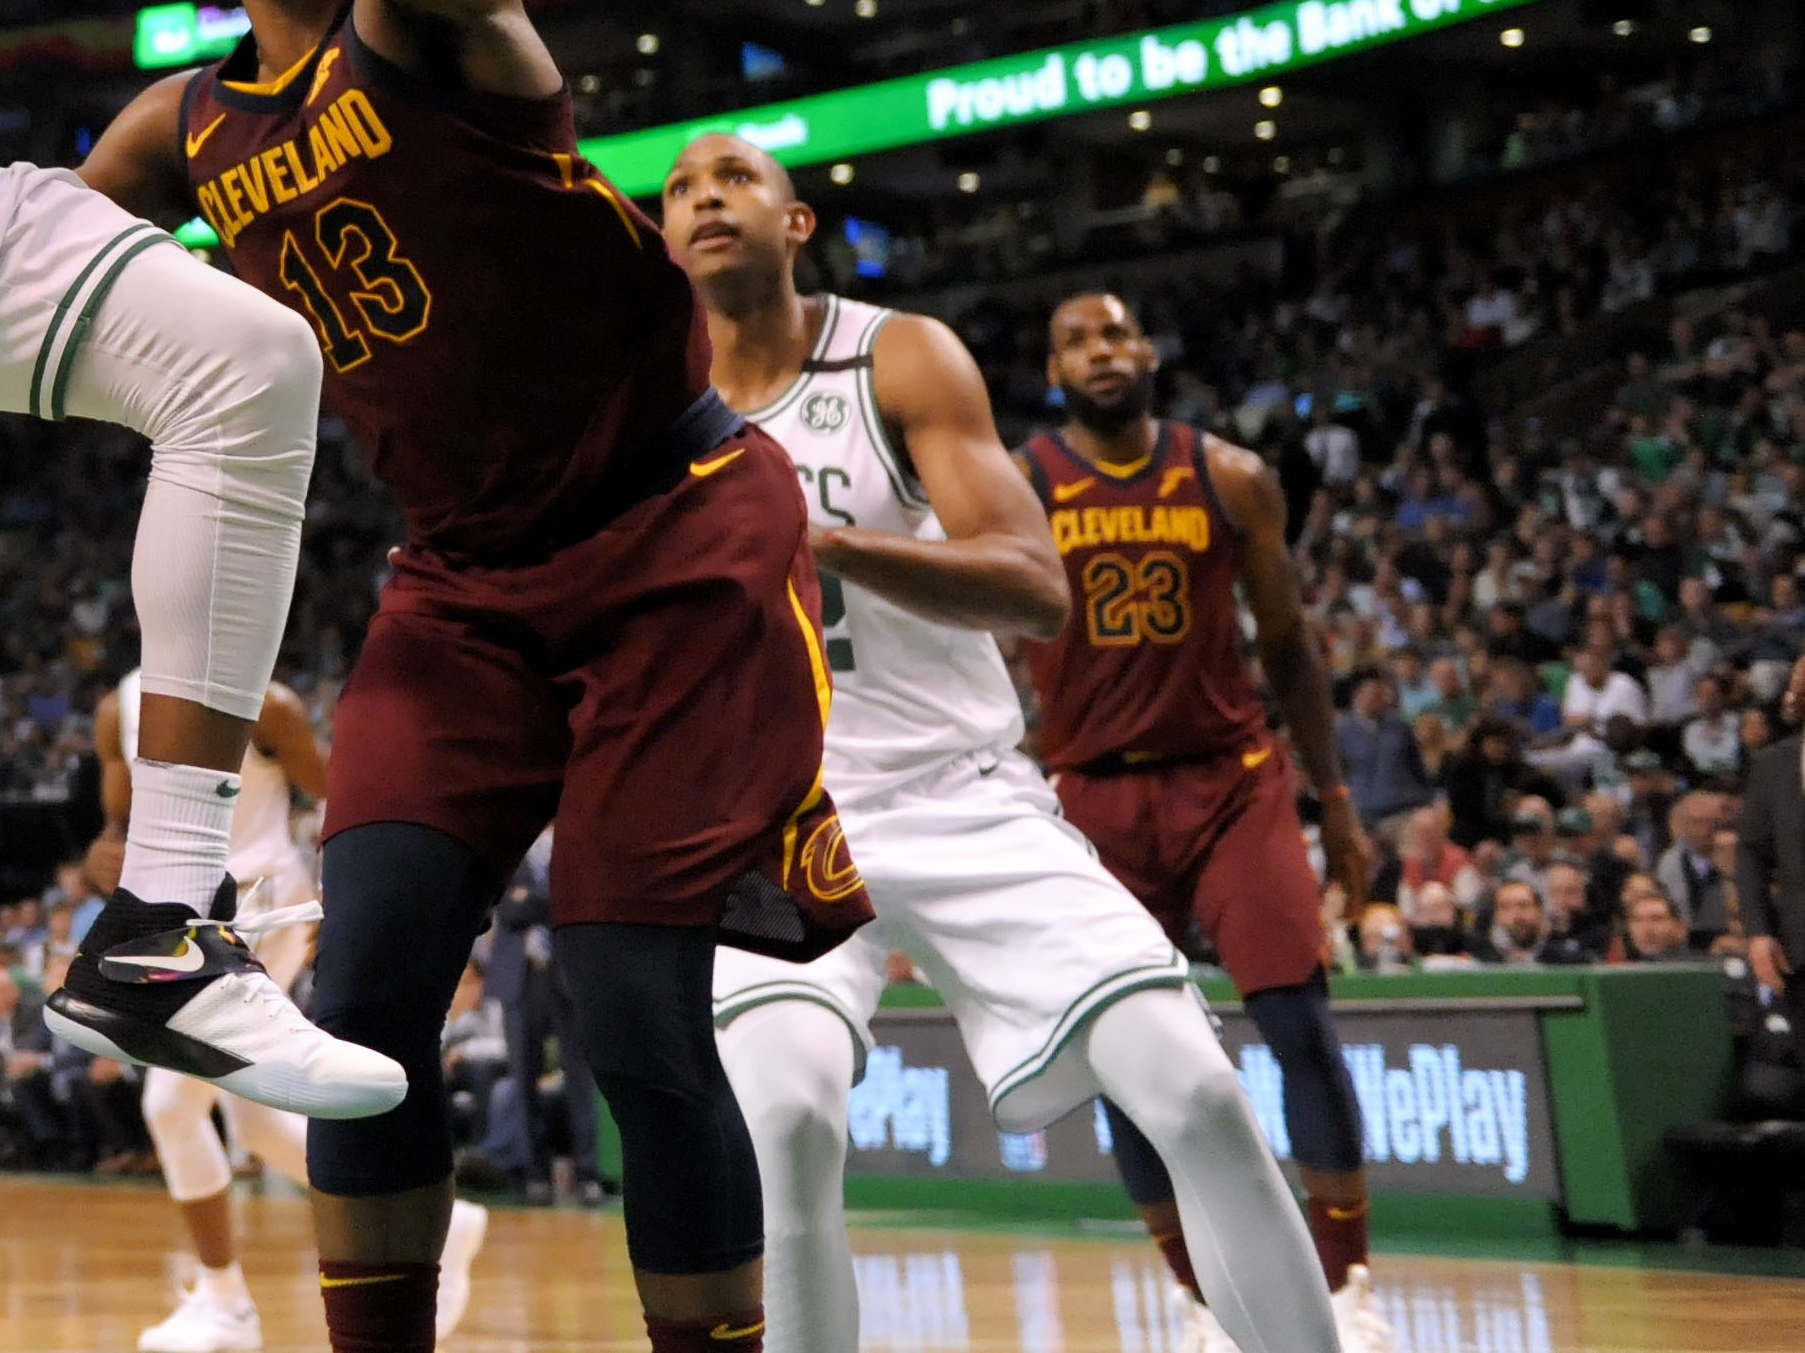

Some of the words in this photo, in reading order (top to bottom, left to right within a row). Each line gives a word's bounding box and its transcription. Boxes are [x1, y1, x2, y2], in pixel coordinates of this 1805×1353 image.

[925, 51, 1068, 131] Proud
[1073, 50, 1133, 102] to
[1139, 34, 1208, 91] be
[1214, 15, 1293, 77] the
[197, 88, 392, 249] CLEVELAND
[280, 197, 432, 373] 13
[1050, 505, 1211, 557] CLEVELAND
[1082, 550, 1192, 648] 23
